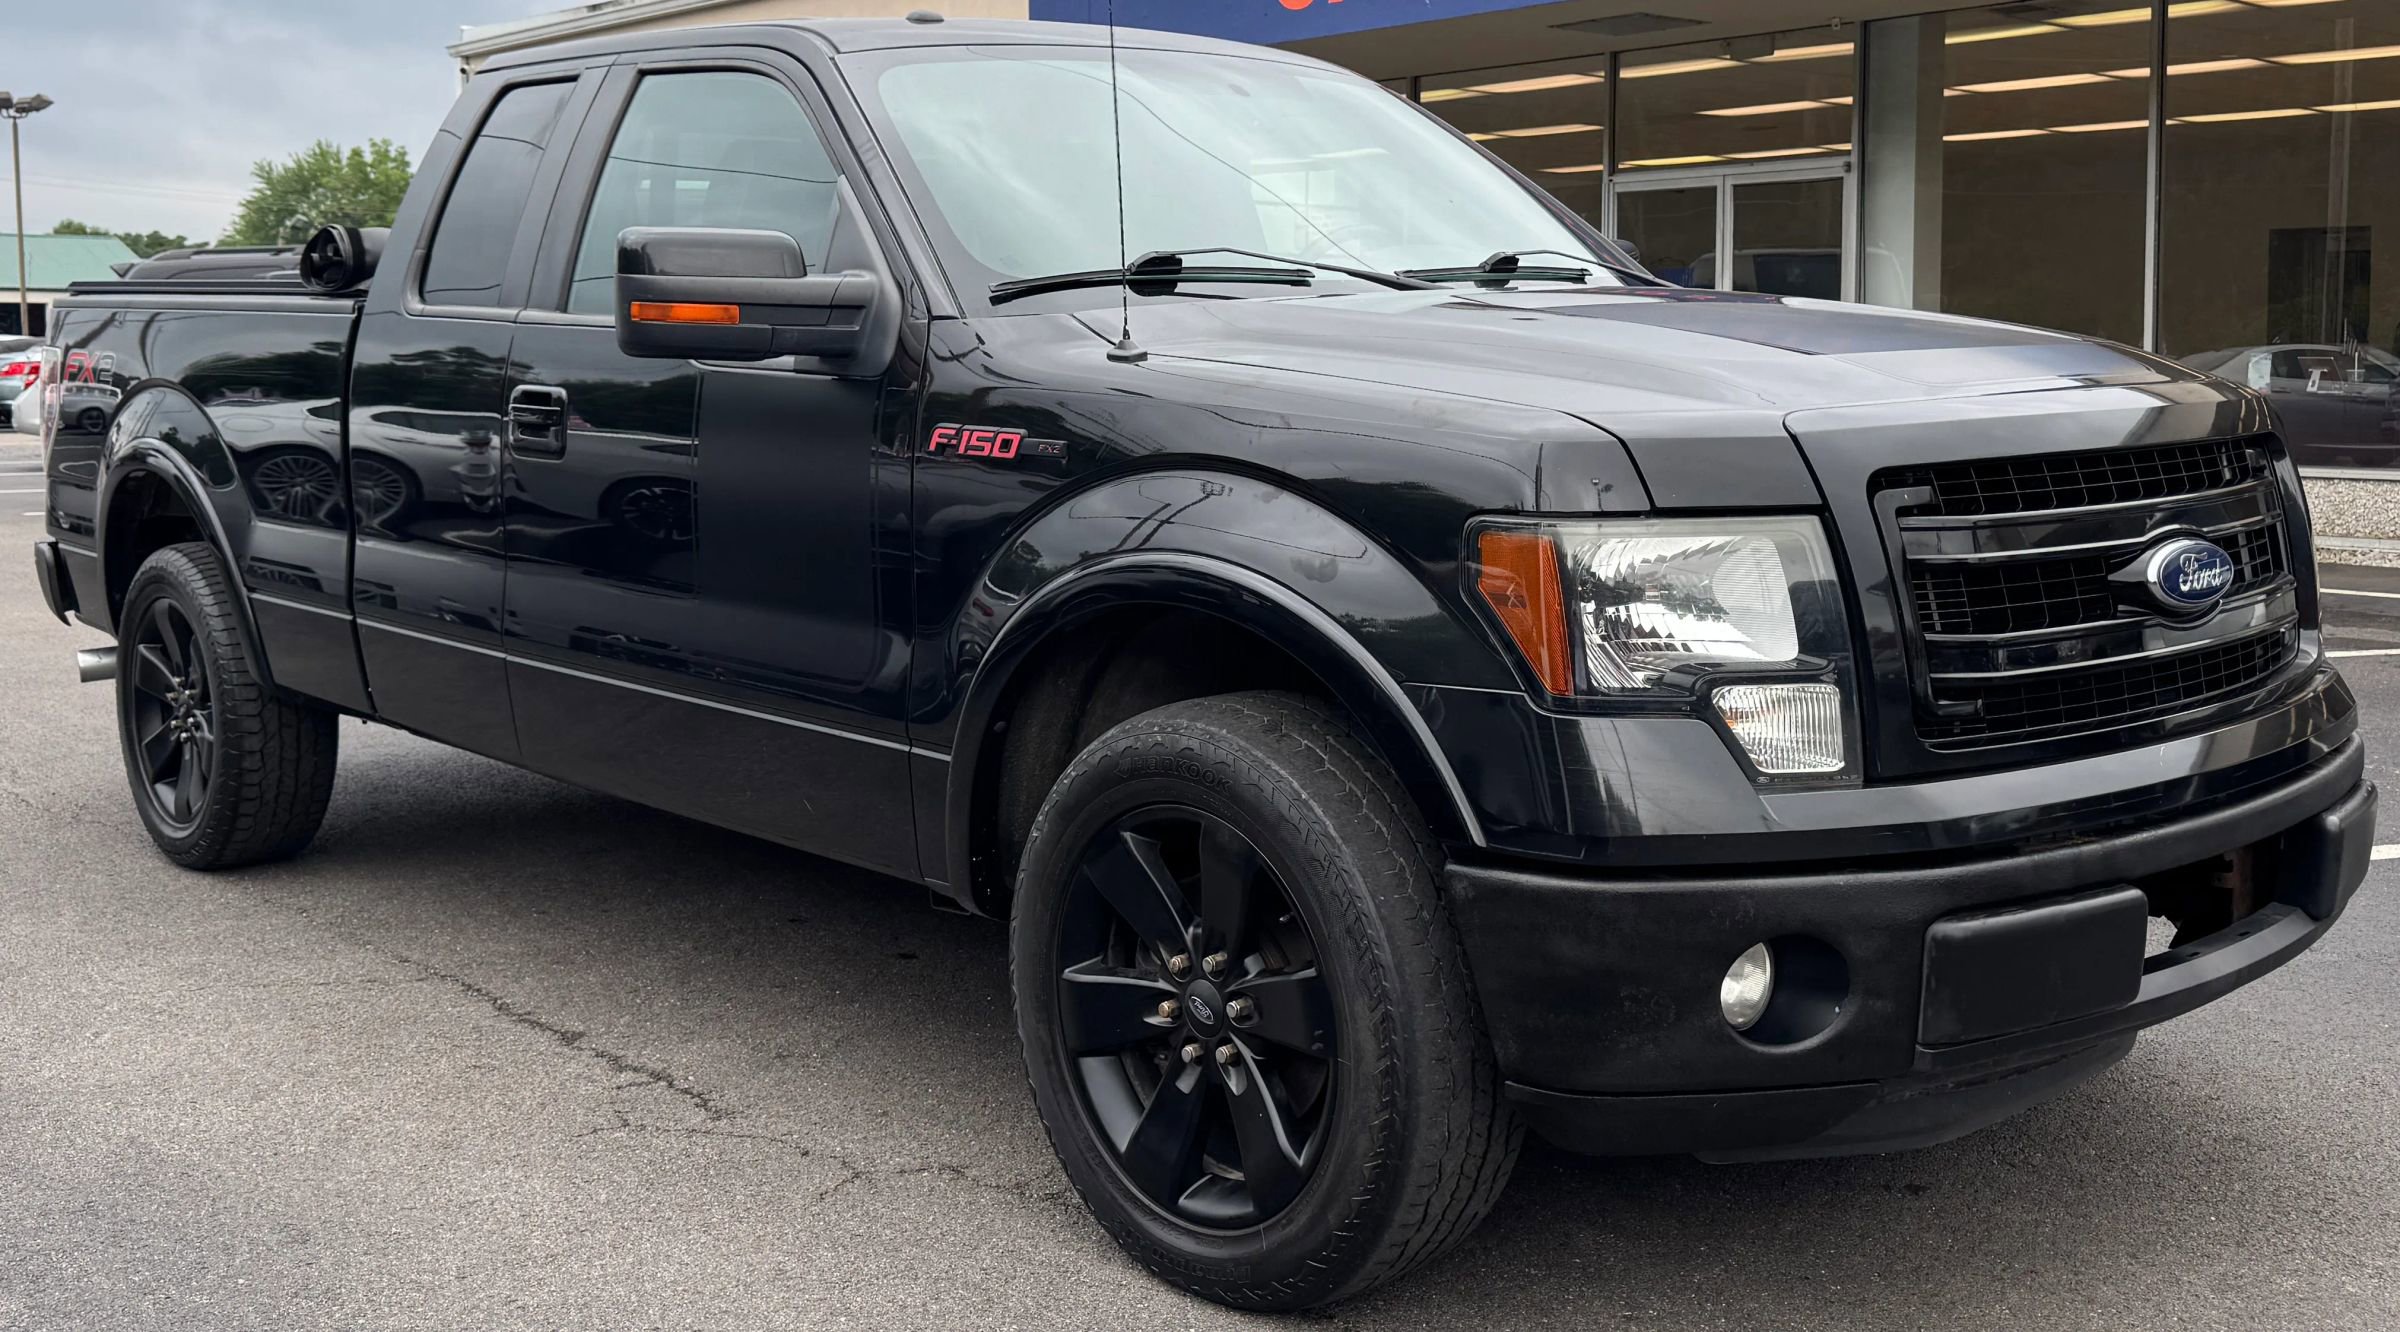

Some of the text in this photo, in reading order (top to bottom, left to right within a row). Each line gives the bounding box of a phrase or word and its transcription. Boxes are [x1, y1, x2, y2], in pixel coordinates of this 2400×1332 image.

[62, 349, 116, 386] FX2
[927, 424, 1061, 460] F-150 FX2
[2178, 551, 2230, 592] Ford
